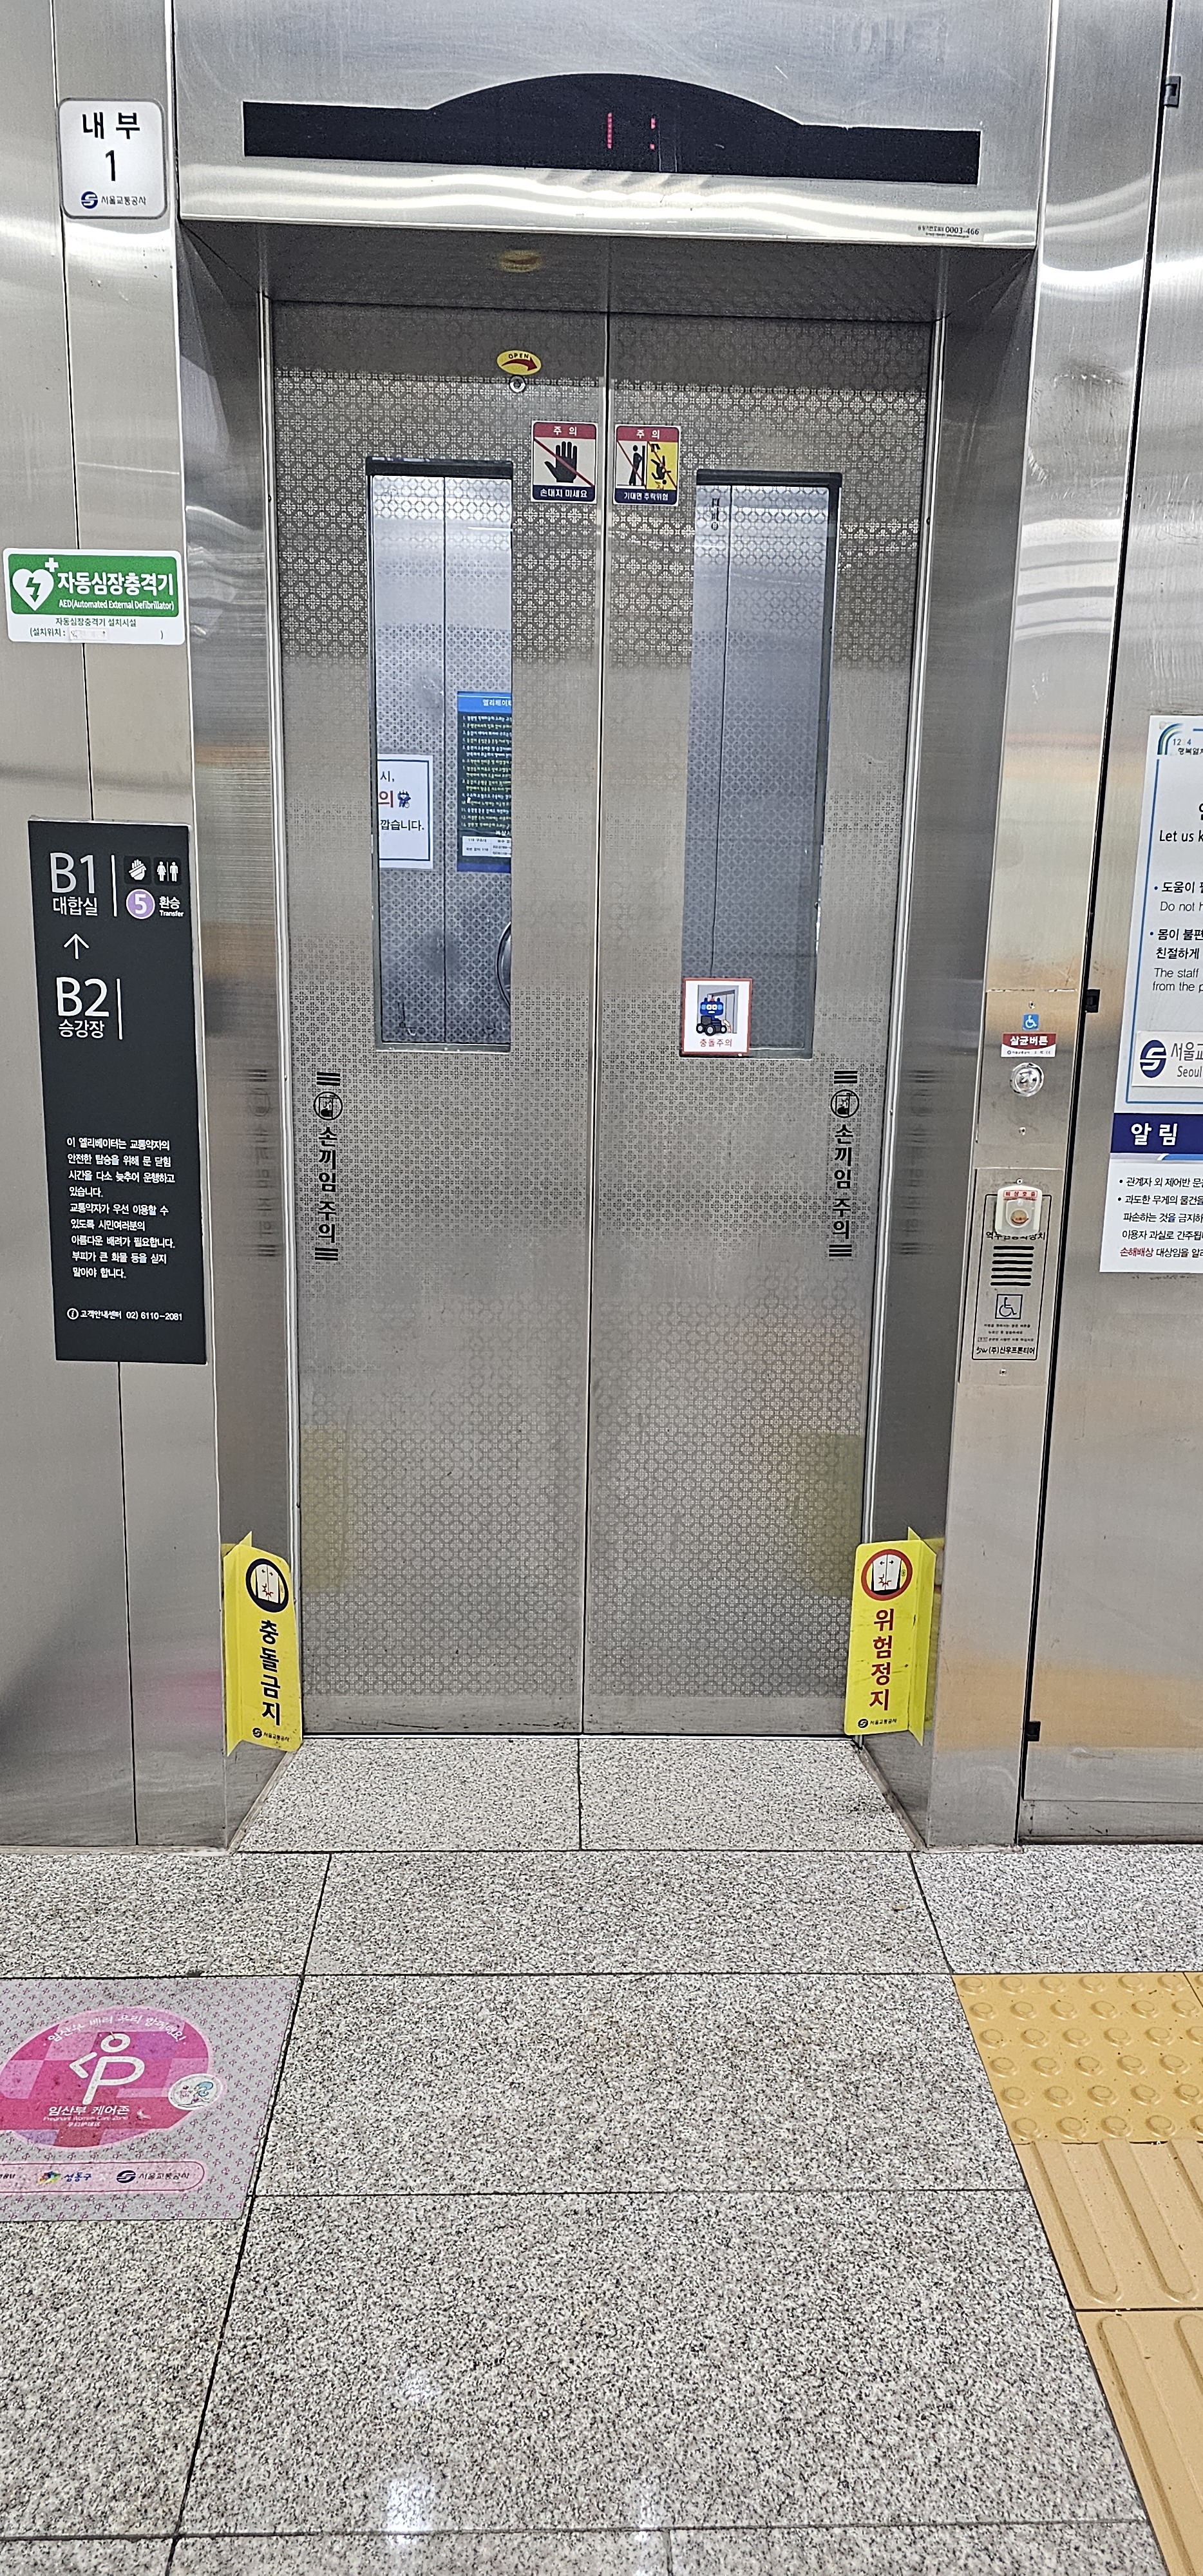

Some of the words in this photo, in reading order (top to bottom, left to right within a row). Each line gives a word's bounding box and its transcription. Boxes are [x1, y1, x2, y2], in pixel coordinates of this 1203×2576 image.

[105, 149, 116, 182] 1
[101, 196, 146, 205] 서울교통공사
[945, 226, 980, 235] 0003-466
[540, 488, 563, 498] 손대지
[623, 492, 642, 500] 기대면
[57, 571, 173, 596] 자동심장충격기
[59, 600, 108, 609] AED(Automated
[109, 600, 134, 609] External
[135, 601, 175, 611] Defibrillator)
[55, 618, 106, 627] 자동심장충격기
[108, 619, 137, 627] 설치시설
[380, 771, 395, 782] 시,
[1159, 830, 1177, 842] Let
[1181, 833, 1194, 842] us
[50, 852, 95, 894] B1
[1162, 882, 1195, 893] 도움이
[53, 896, 98, 916] 대합실
[135, 893, 147, 914] 5
[159, 896, 181, 909] 환승
[1160, 902, 1175, 912] Do
[1179, 902, 1195, 912] not
[1157, 929, 1179, 941] 몸이
[1156, 947, 1200, 960] 친절하게
[1154, 968, 1173, 978] The
[1177, 968, 1199, 978] staff
[1153, 981, 1175, 991] from
[1179, 982, 1195, 992] the
[56, 976, 109, 1018] B2
[59, 1019, 105, 1039] 승강장
[700, 1039, 732, 1047] 충돌주의
[1177, 1066, 1202, 1078] Seoul
[66, 1137, 75, 1147] 이
[79, 1138, 127, 1150] 엘리베이터는
[129, 1140, 170, 1151] 교통약자의
[67, 1153, 92, 1164] 안전한
[95, 1155, 119, 1165] 탑승을
[123, 1155, 139, 1166] 위해
[142, 1156, 151, 1166] 문
[155, 1157, 171, 1167] 닫힘
[318, 1127, 337, 1192] 손끼임
[834, 1124, 853, 1189] 손끼임
[68, 1170, 92, 1181] 시간을
[97, 1171, 113, 1182] 다소
[115, 1172, 140, 1182] 늦추어
[143, 1173, 175, 1183] 운행하고
[1126, 1177, 1152, 1187] 관계자
[1154, 1177, 1163, 1187] 외
[1165, 1177, 1191, 1188] 제어반
[1193, 1178, 1203, 1188] 문
[70, 1187, 103, 1197] 있습니다.
[1124, 1195, 1151, 1205] 과도한
[1152, 1195, 1178, 1205] 무게의
[1180, 1196, 1203, 1206] 물건을
[70, 1204, 109, 1214] 교통약자가
[113, 1204, 129, 1215] 우선
[133, 1205, 156, 1216] 이용할
[160, 1206, 169, 1216] 수
[317, 1201, 336, 1243] 주의
[832, 1198, 851, 1239] 주의
[1123, 1213, 1157, 1223] 파손하는
[1159, 1213, 1176, 1223] 것을
[71, 1219, 95, 1230] 있도록
[99, 1220, 146, 1231] 시민여러분의
[1122, 1230, 1147, 1240] 이용자
[1149, 1231, 1174, 1240] 과실로
[1177, 1231, 1203, 1240] 간주됩
[71, 1235, 103, 1245] 아름다운
[106, 1236, 130, 1247] 배려가
[134, 1236, 175, 1249] 필요합니다.
[72, 1251, 96, 1262] 부피가
[99, 1252, 108, 1262] 큰
[111, 1253, 128, 1263] 화물
[131, 1253, 147, 1263] 등을
[151, 1254, 167, 1264] 싣지
[1120, 1247, 1153, 1258] 손해배상
[1156, 1248, 1189, 1258] 대상임을
[73, 1267, 97, 1278] 말아야
[100, 1268, 126, 1278] 합니다.
[80, 1311, 122, 1320] 고객안내센터
[126, 1311, 138, 1320] 02)
[140, 1311, 182, 1321] 6110-2081
[869, 1608, 895, 1710] 위험정지
[259, 1620, 281, 1726] 충돌금지
[49, 2106, 86, 2116] 임산부
[91, 2105, 129, 2115] 케어존
[64, 2172, 91, 2182] 성동구
